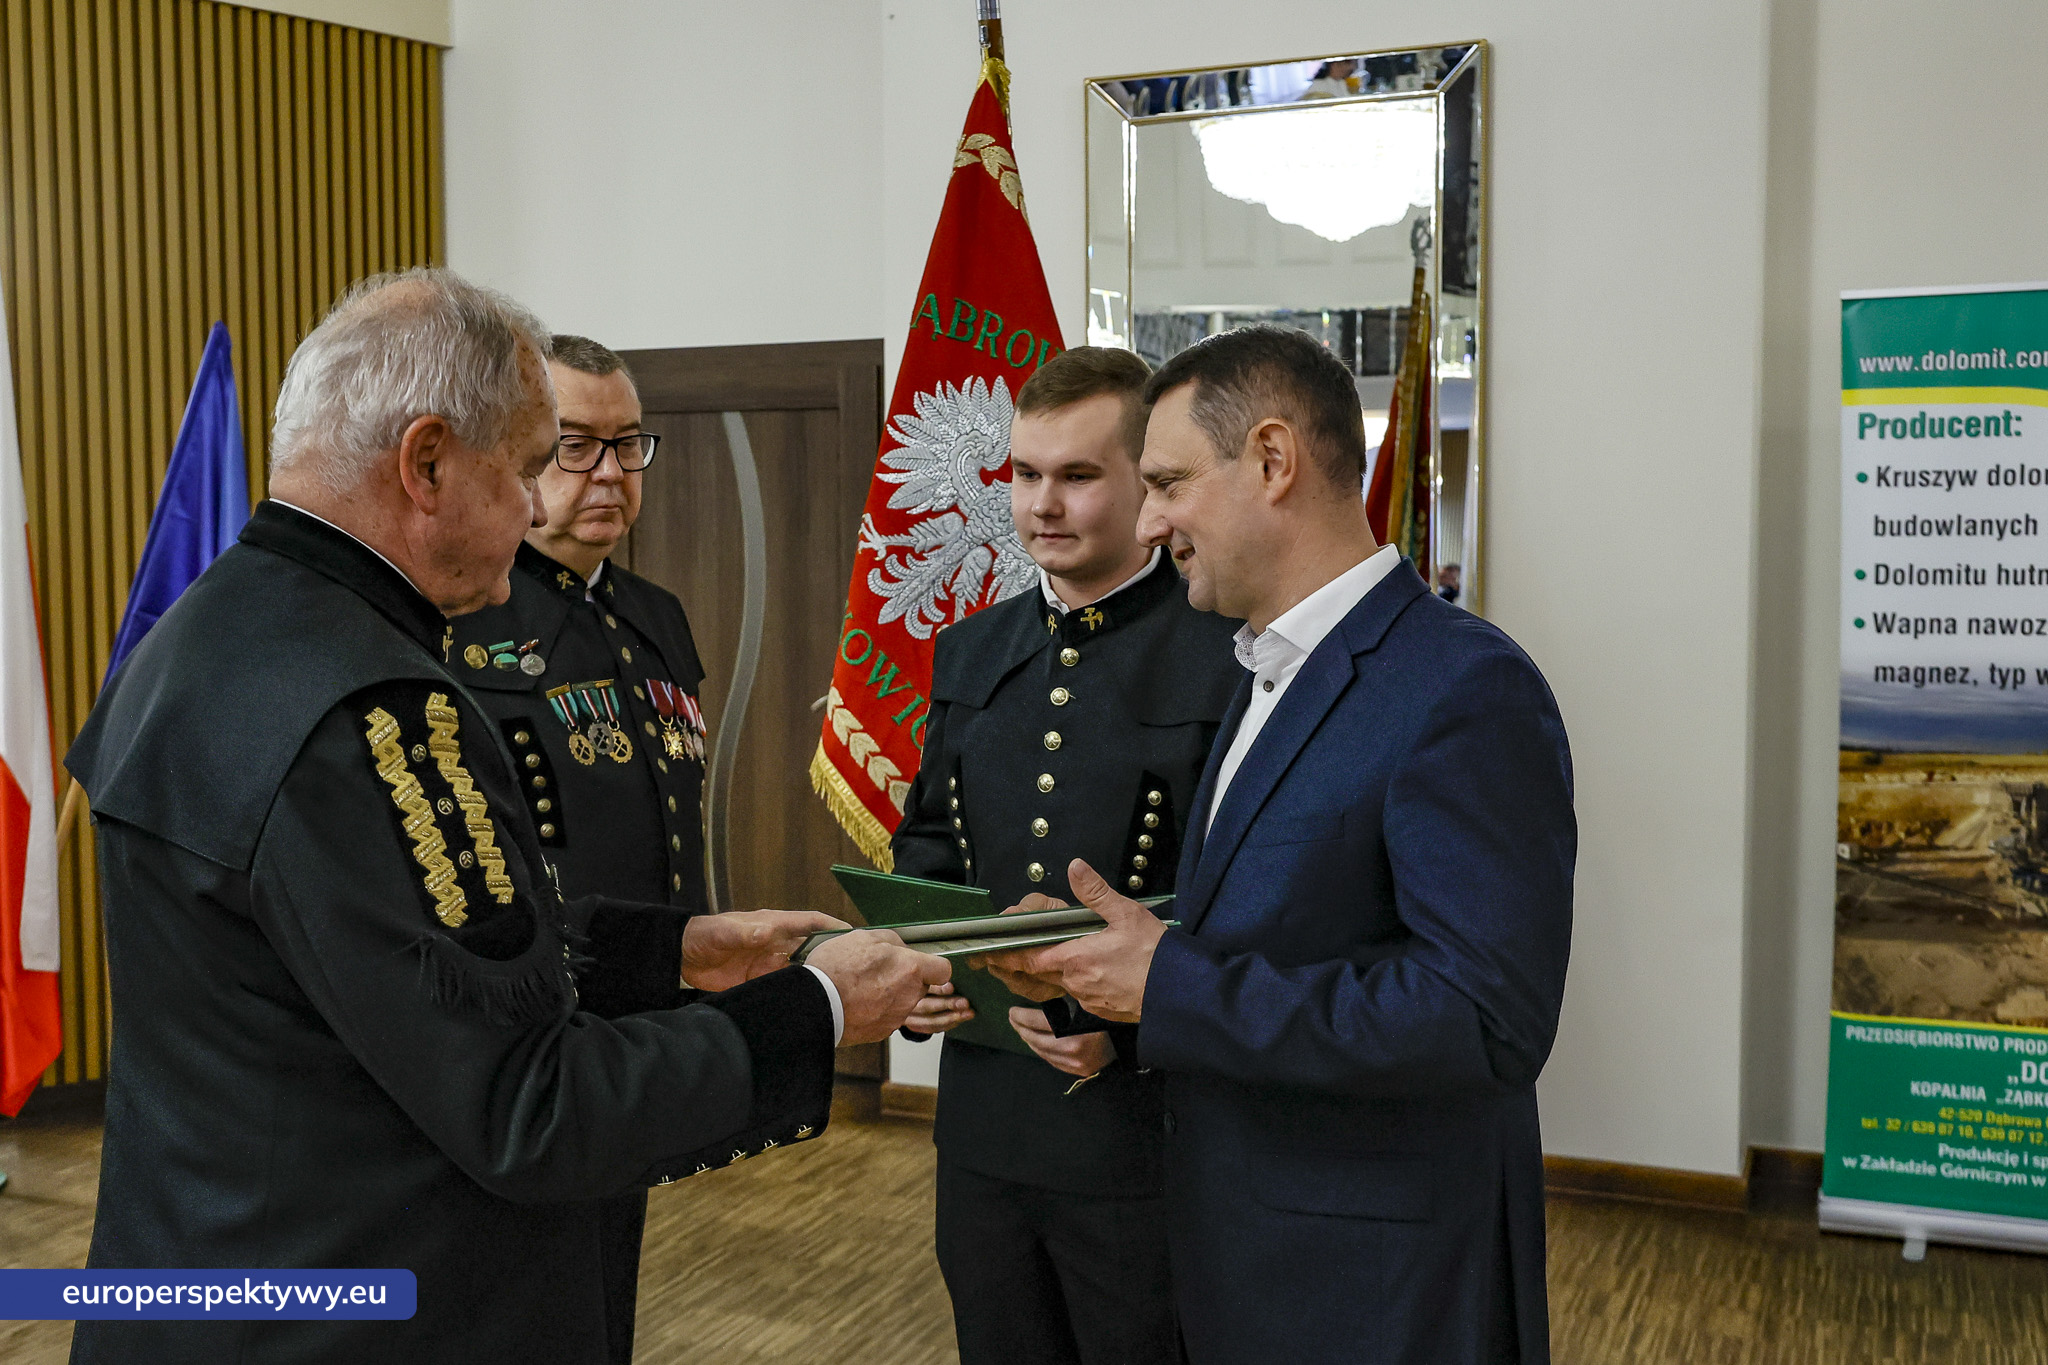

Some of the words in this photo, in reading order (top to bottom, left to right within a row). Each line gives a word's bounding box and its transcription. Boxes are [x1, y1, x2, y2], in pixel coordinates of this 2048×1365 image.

[1859, 348, 2048, 373] www.dolomit.co
[1858, 409, 2023, 440] Producent:
[1876, 464, 1977, 492] Kruszyw
[1987, 463, 2048, 486] dolo
[1874, 513, 2038, 541] budowlanych
[1874, 563, 1986, 586] Dolomitu
[1873, 611, 1957, 640] Wapna
[1968, 616, 2048, 636] nawoz
[1874, 664, 1979, 689] magnez,
[1989, 662, 2026, 691] typ
[1845, 1024, 1999, 1052] PRZEDSIĘBIORSTWO
[1911, 1080, 1987, 1103] KOPALNIA
[1937, 1142, 2021, 1169] Produkcję
[2022, 1150, 2029, 1167] i
[1842, 1156, 1858, 1169] w
[1860, 1154, 1937, 1177] Zakładzie
[1940, 1162, 2028, 1187] Górniczym
[2030, 1173, 2048, 1188] w
